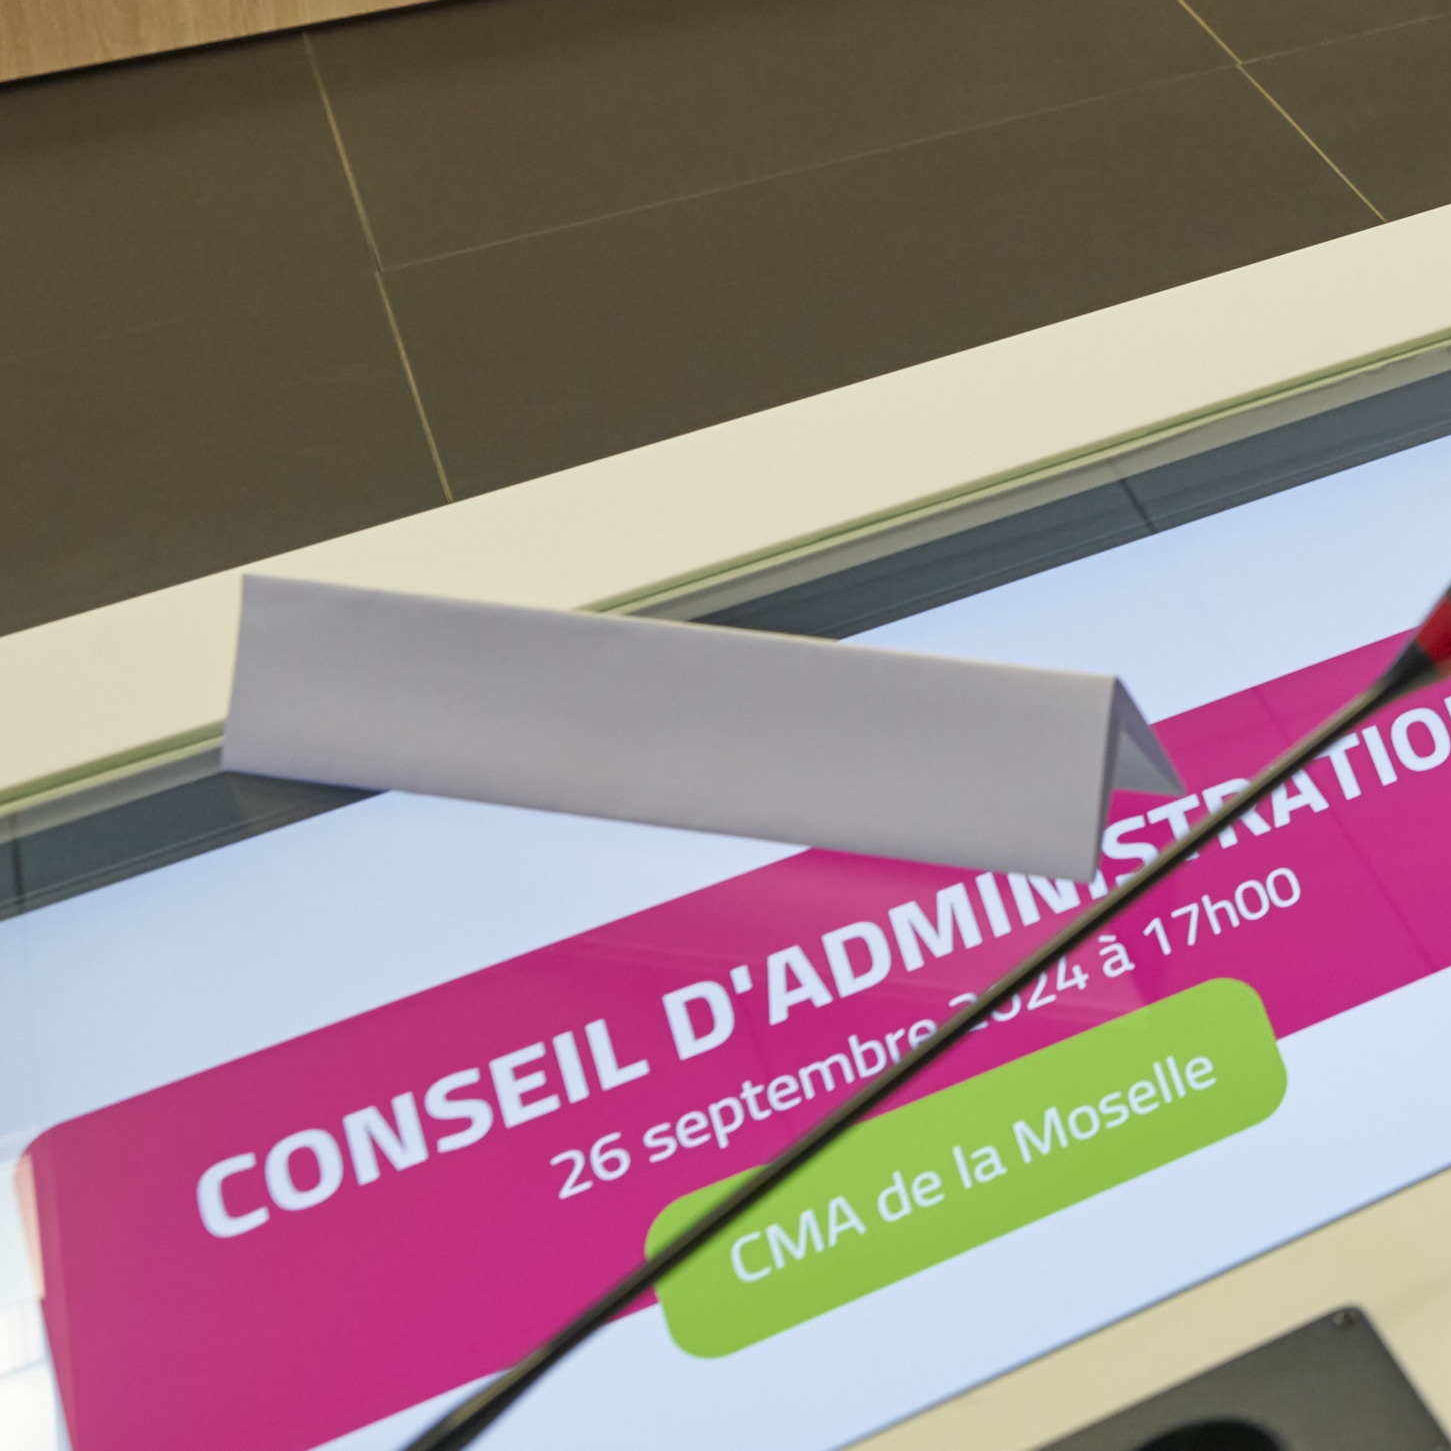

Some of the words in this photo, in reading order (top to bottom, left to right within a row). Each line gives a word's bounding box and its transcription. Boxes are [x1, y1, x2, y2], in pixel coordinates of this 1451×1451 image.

[196, 1019, 650, 1238] CONSEIL
[550, 1132, 632, 1200] 26
[642, 1016, 938, 1164] septembre
[1098, 934, 1136, 979] à
[1142, 867, 1301, 957] 17h00
[729, 1197, 868, 1282] CMA
[876, 1170, 945, 1223] de
[951, 1144, 1008, 1189] la
[1012, 1054, 1218, 1165] Moselle
